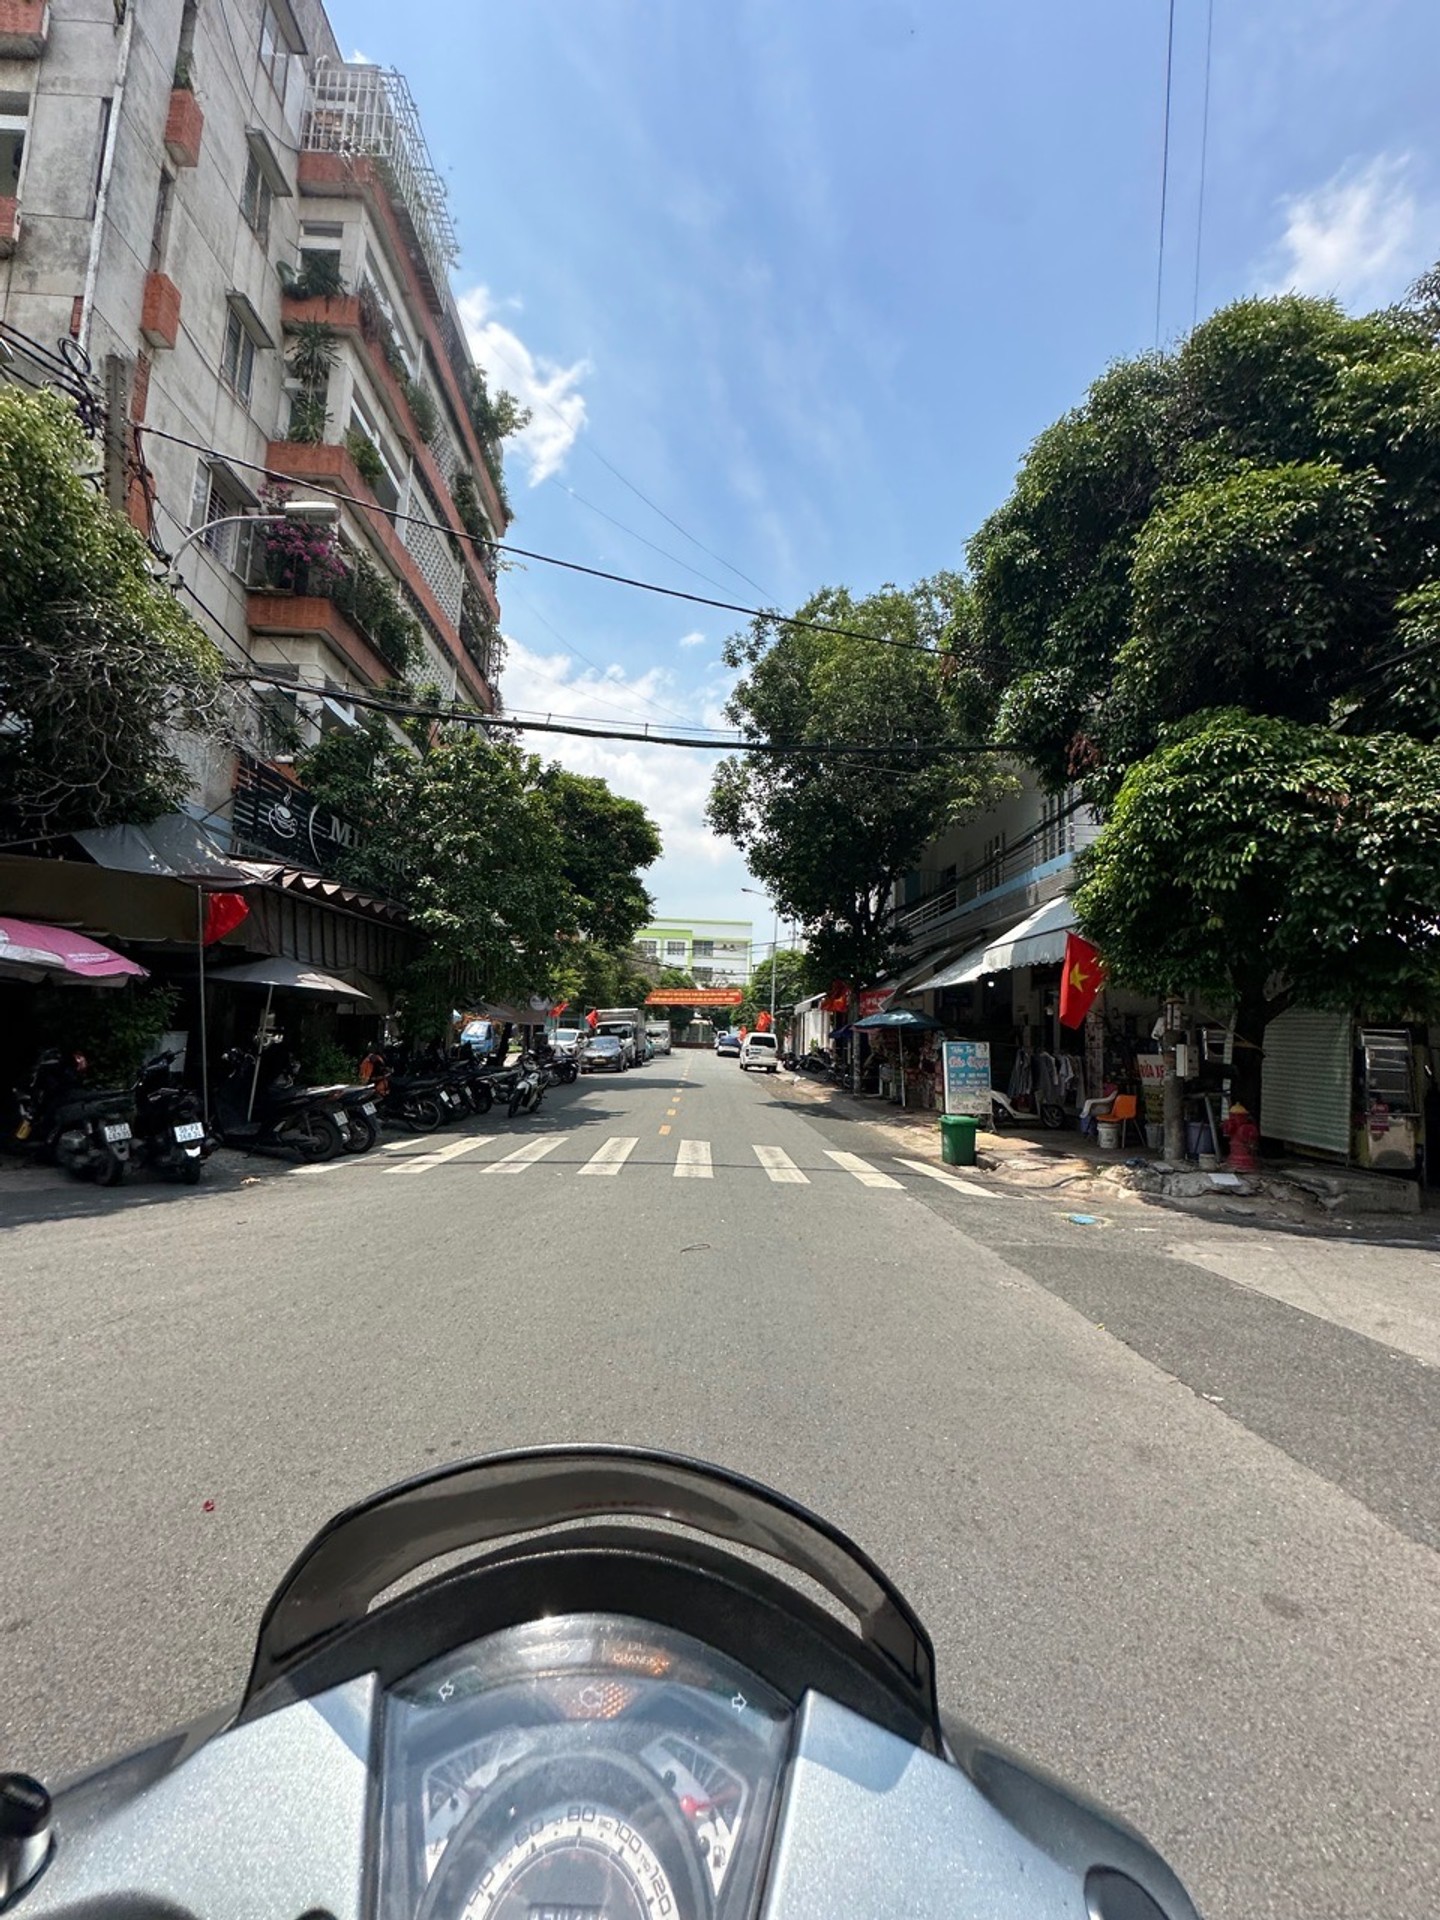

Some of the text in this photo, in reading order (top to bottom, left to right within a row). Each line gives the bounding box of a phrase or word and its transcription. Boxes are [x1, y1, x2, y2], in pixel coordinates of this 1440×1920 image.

[567, 1806, 596, 1822] 80
[615, 1819, 642, 1854] 100
[650, 1864, 672, 1916] 120
